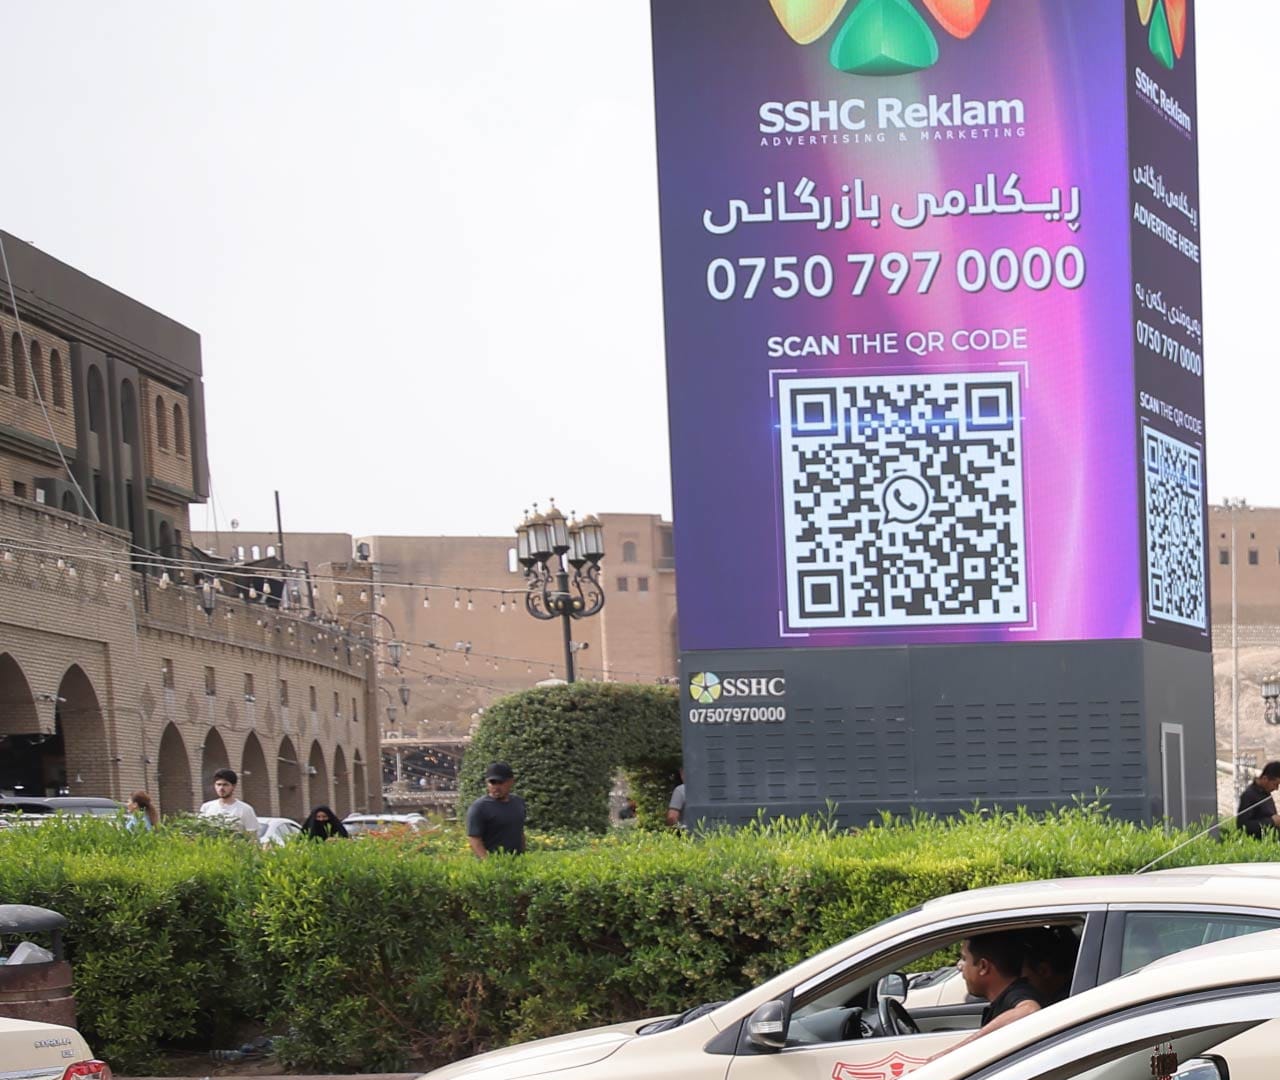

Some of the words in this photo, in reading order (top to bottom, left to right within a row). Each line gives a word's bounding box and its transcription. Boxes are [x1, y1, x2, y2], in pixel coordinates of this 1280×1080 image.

[758, 98, 865, 135] SSHC
[877, 94, 1025, 130] Reklam
[1135, 67, 1159, 105] SSHC
[1160, 89, 1191, 131] Reklam
[760, 133, 886, 147] ADVERTISING
[920, 127, 1026, 142] MARKETING
[1133, 203, 1178, 249] ADVERTISE
[1178, 234, 1199, 263] HERE
[706, 254, 834, 301] 0750
[847, 250, 940, 297] 797
[957, 245, 1085, 293] 0000
[767, 333, 840, 358] SCAN
[846, 332, 897, 355] THE
[905, 330, 945, 355] QR
[951, 328, 1028, 351] CODE
[1136, 320, 1160, 354] 0750
[1161, 334, 1178, 364] 797
[1180, 345, 1202, 376] 0000
[1140, 391, 1159, 415] SCAN
[722, 677, 786, 697] SSHC
[689, 706, 786, 723] 07507970000
